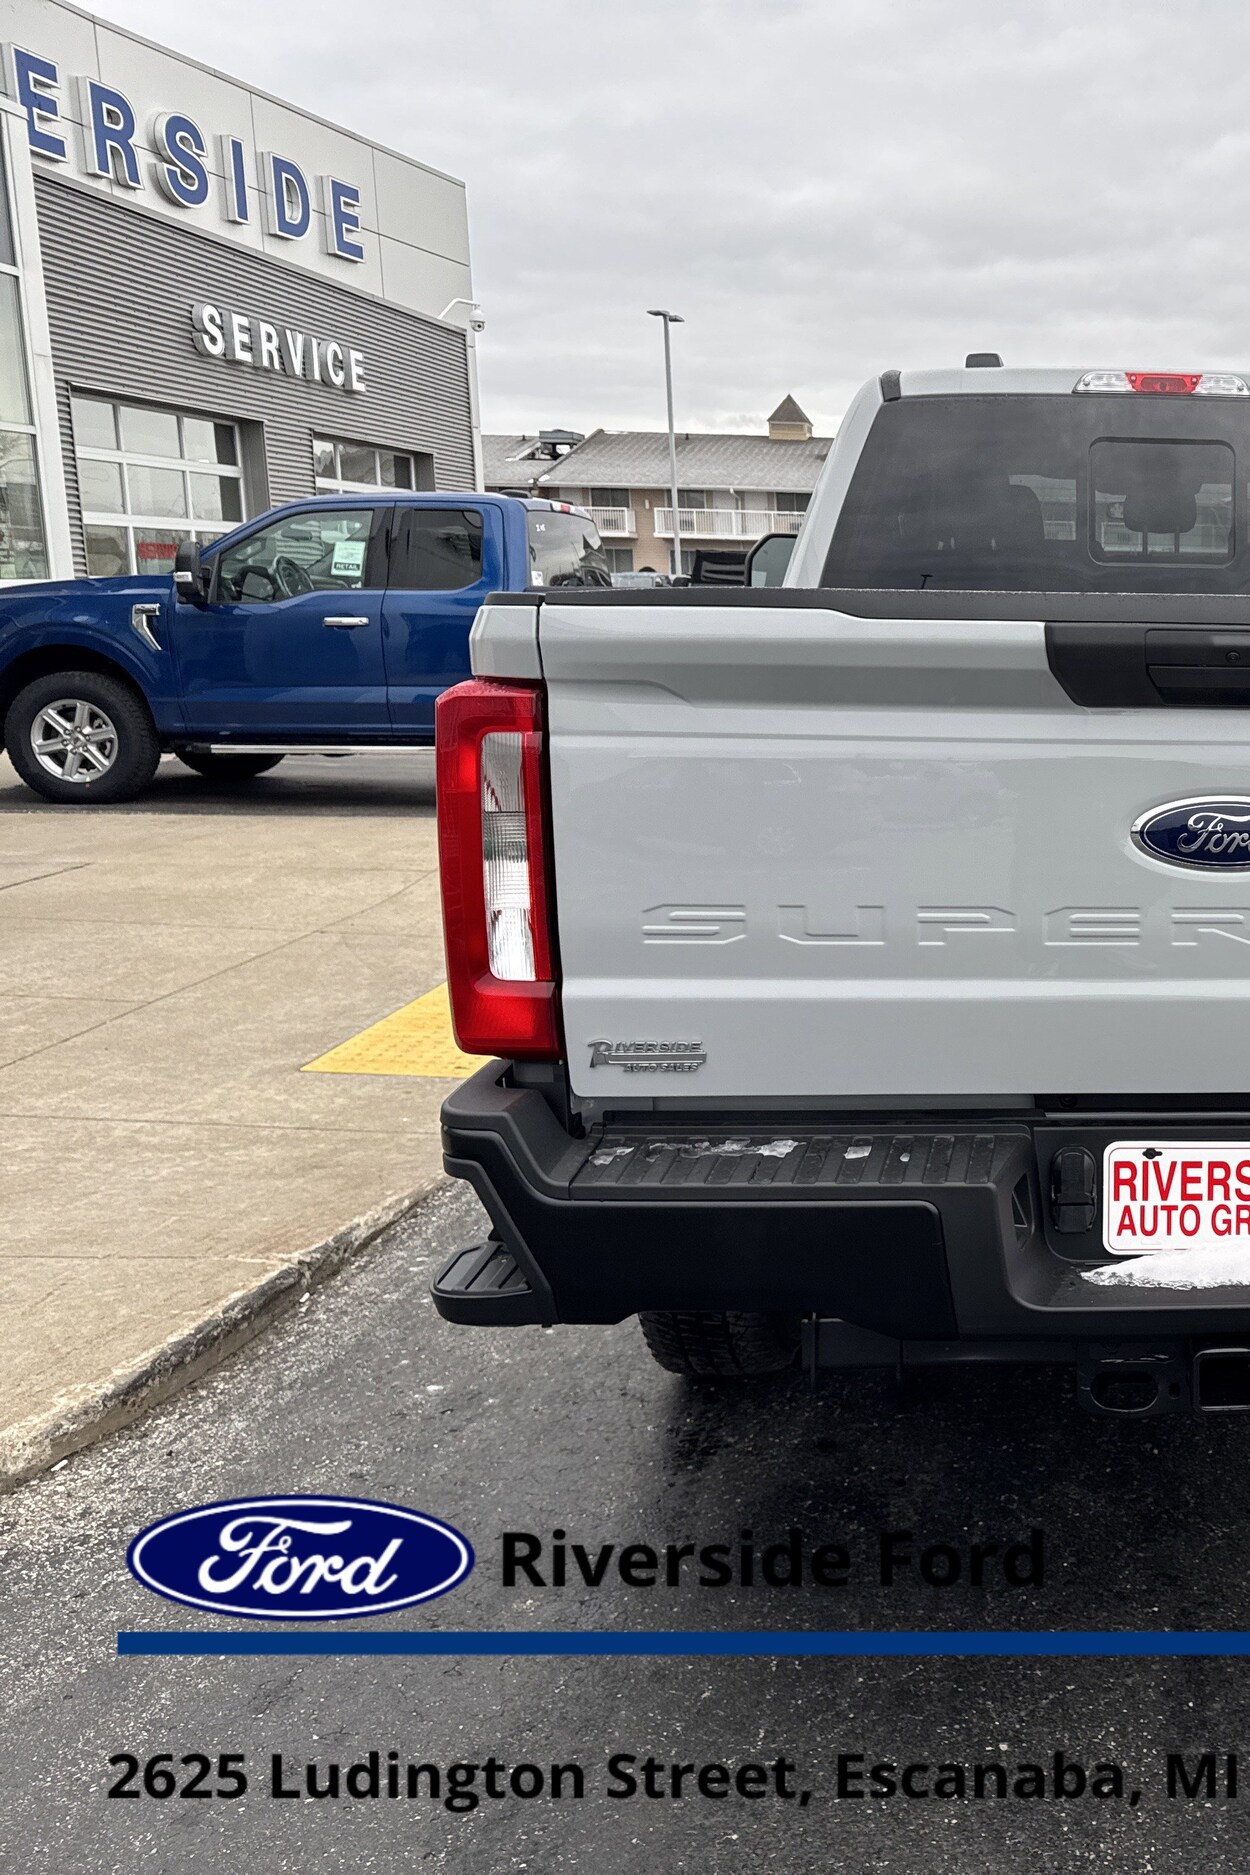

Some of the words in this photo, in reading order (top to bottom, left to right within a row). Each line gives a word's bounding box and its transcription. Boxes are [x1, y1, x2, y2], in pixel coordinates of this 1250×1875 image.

[9, 41, 366, 263] ERSIDE
[195, 303, 366, 392] SERVICE
[588, 1039, 703, 1068] RIVERSIDE
[623, 1063, 658, 1073] AUTO
[659, 1063, 699, 1073] SALES
[1116, 1204, 1201, 1237] AUTO
